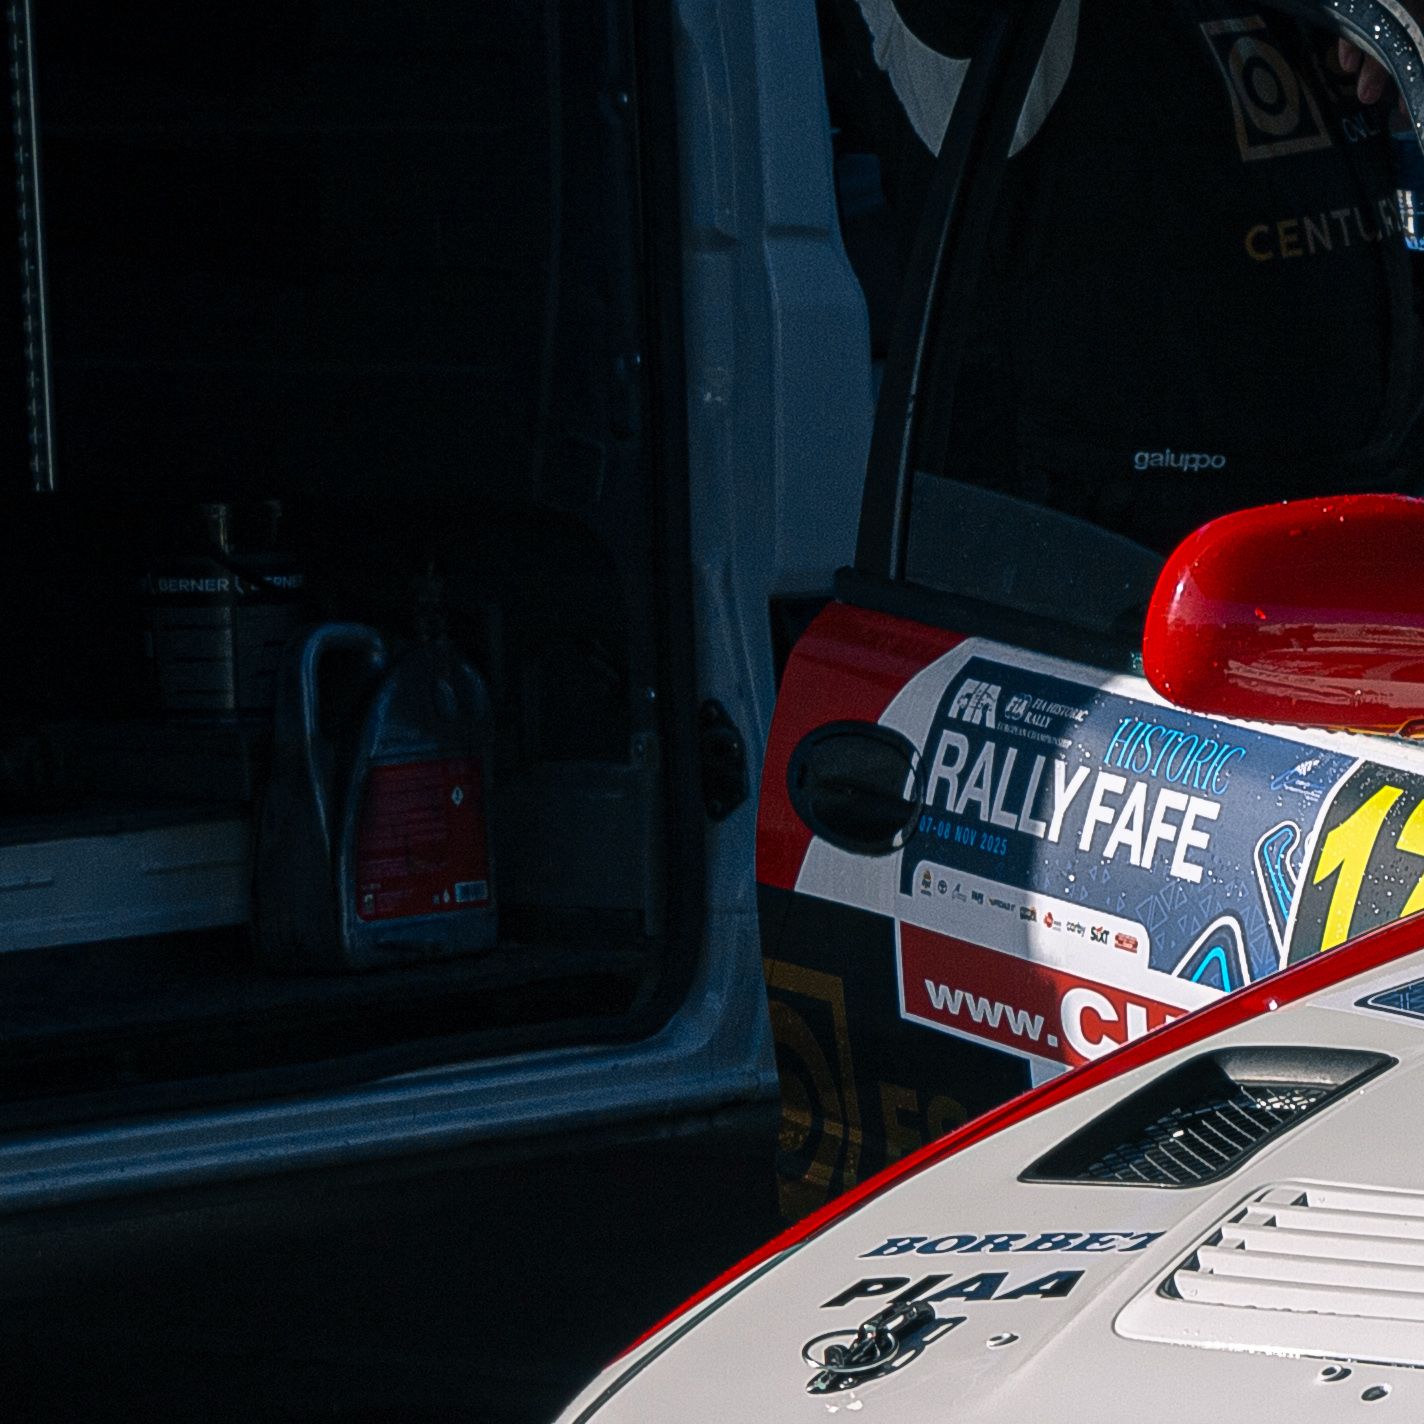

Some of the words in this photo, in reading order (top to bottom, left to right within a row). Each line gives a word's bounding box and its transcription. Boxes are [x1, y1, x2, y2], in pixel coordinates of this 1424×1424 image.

[1134, 449, 1226, 472] galuppo
[158, 576, 230, 593] BERNER
[1025, 711, 1052, 729] RALLY
[1103, 717, 1246, 796] HISTORIC
[955, 826, 977, 846] NOV
[980, 832, 1009, 856] 2025
[859, 1230, 1168, 1259] BORBET
[822, 1269, 1087, 1308] PIAA
